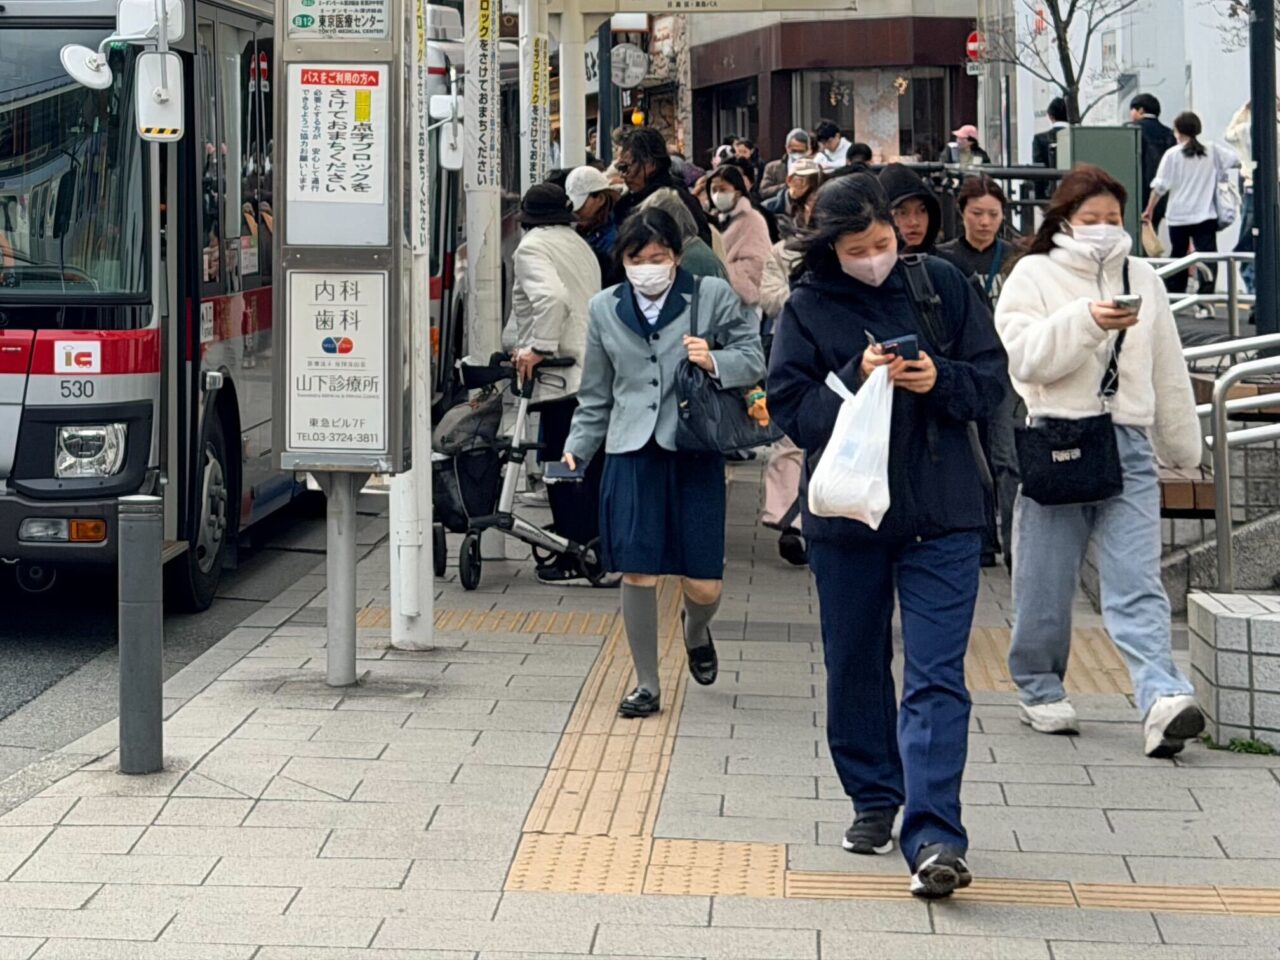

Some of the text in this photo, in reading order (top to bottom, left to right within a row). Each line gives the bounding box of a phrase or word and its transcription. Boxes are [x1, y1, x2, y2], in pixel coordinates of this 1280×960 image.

[318, 14, 384, 28] 東京医療センター
[303, 72, 376, 84] バスをご利用の方へ
[326, 89, 349, 193] さけておまちください
[350, 122, 374, 193] 点字ブロックを
[314, 280, 360, 302] 内科
[314, 309, 361, 331] 歯科
[61, 380, 94, 398] 530
[296, 374, 379, 393] 山下診療所
[309, 417, 366, 428] 東急ビル7F
